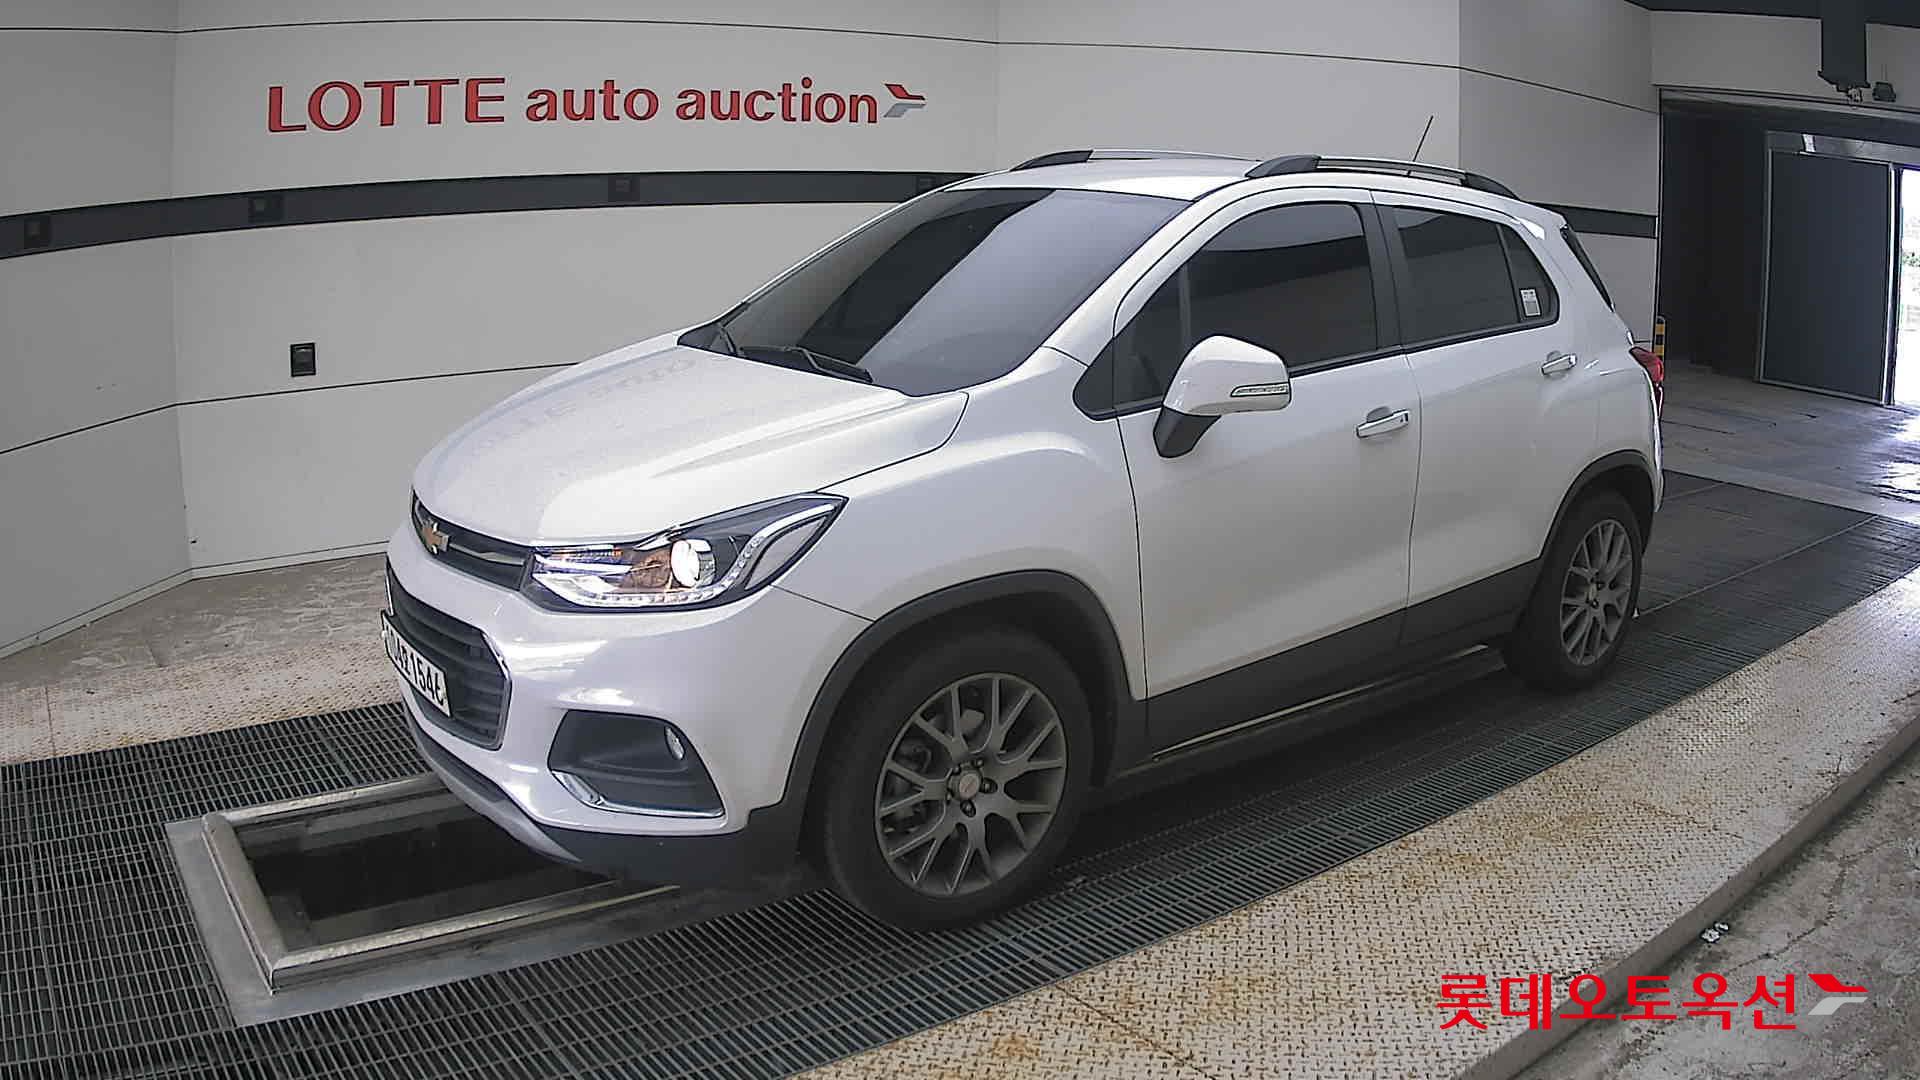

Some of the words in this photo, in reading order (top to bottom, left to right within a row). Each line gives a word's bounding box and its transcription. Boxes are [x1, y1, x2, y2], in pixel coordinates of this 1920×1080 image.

[267, 78, 505, 133] LOTTE
[527, 79, 660, 122] auto
[675, 77, 879, 123] auction
